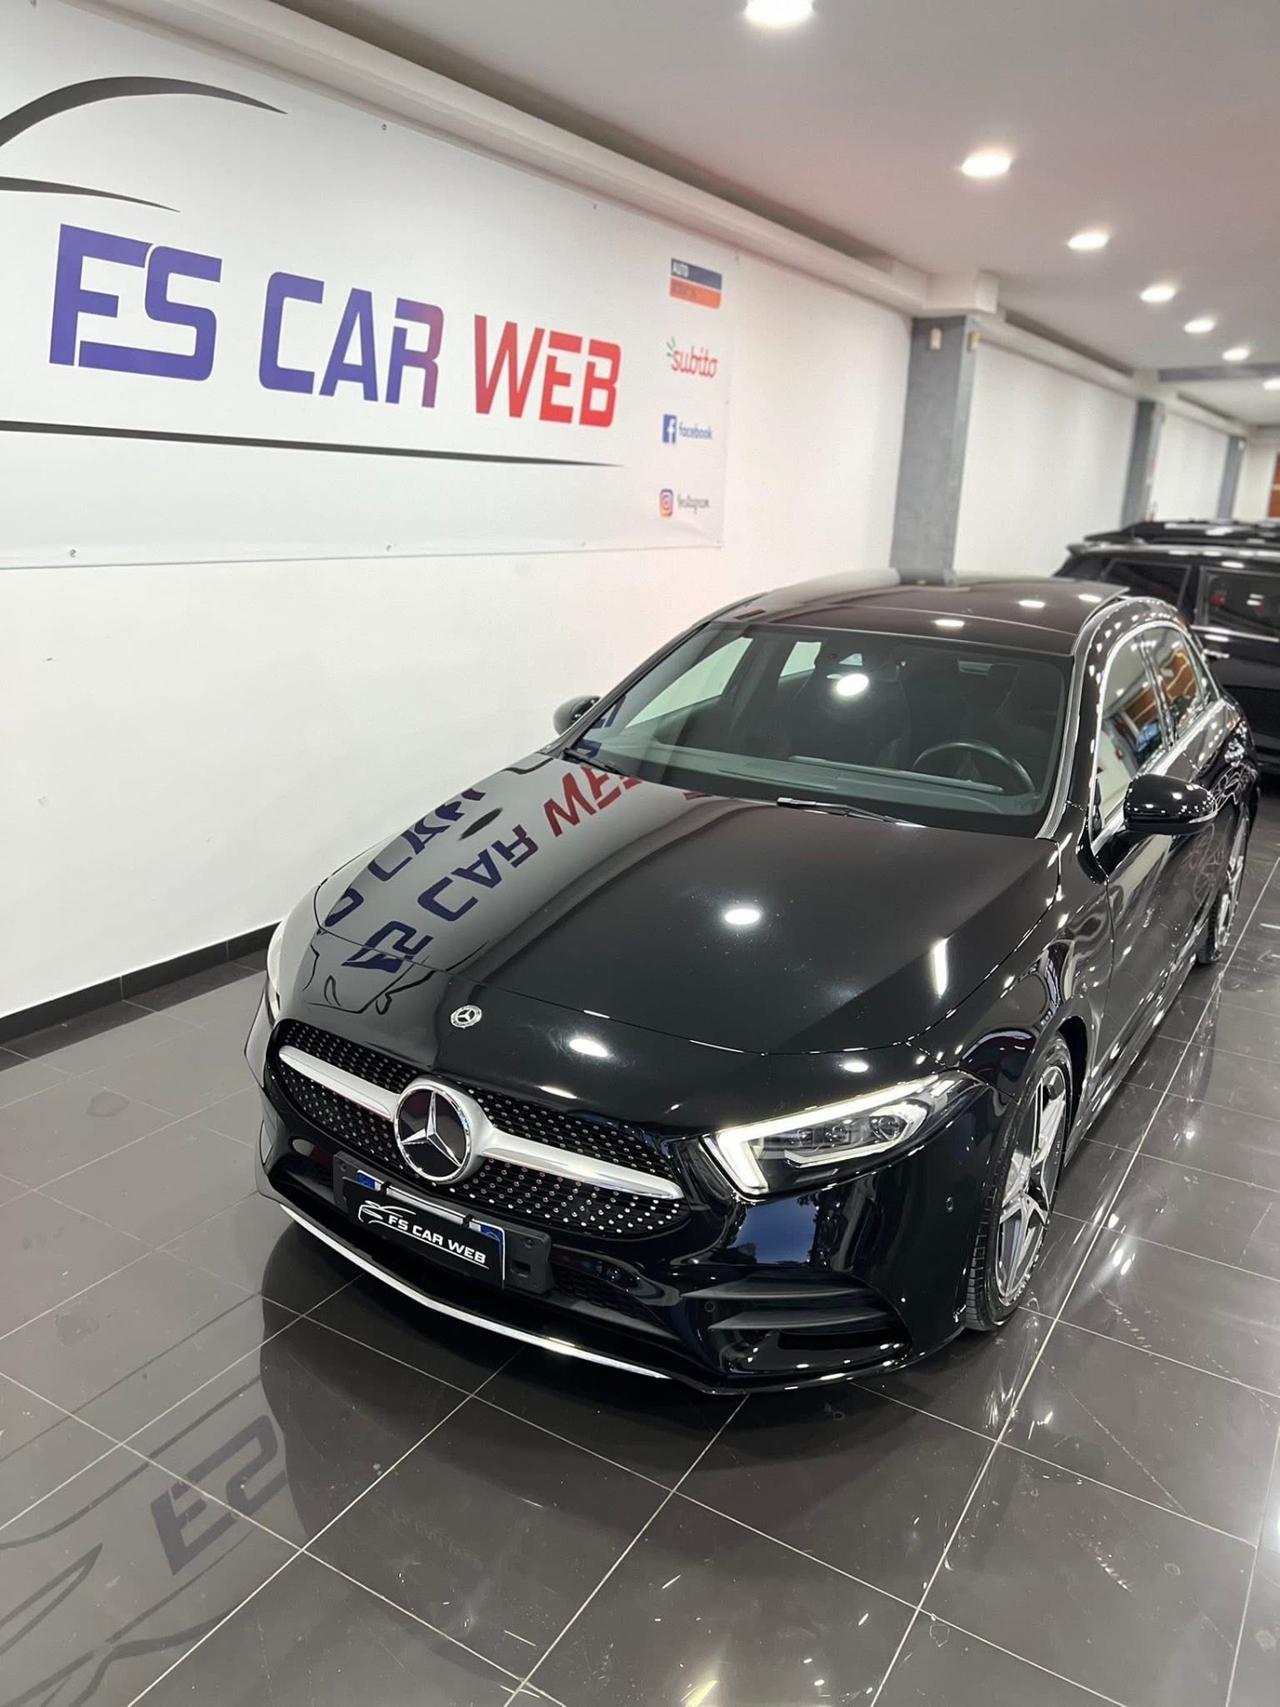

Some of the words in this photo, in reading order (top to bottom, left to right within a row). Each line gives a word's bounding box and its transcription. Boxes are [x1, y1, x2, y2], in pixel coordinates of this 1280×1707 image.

[258, 271, 444, 409] CAR
[473, 314, 622, 428] WEB
[671, 345, 718, 378] subito
[679, 421, 713, 439] facebook
[388, 1214, 409, 1232] FS
[412, 1225, 443, 1247] CAR
[447, 1239, 487, 1265] WEB
